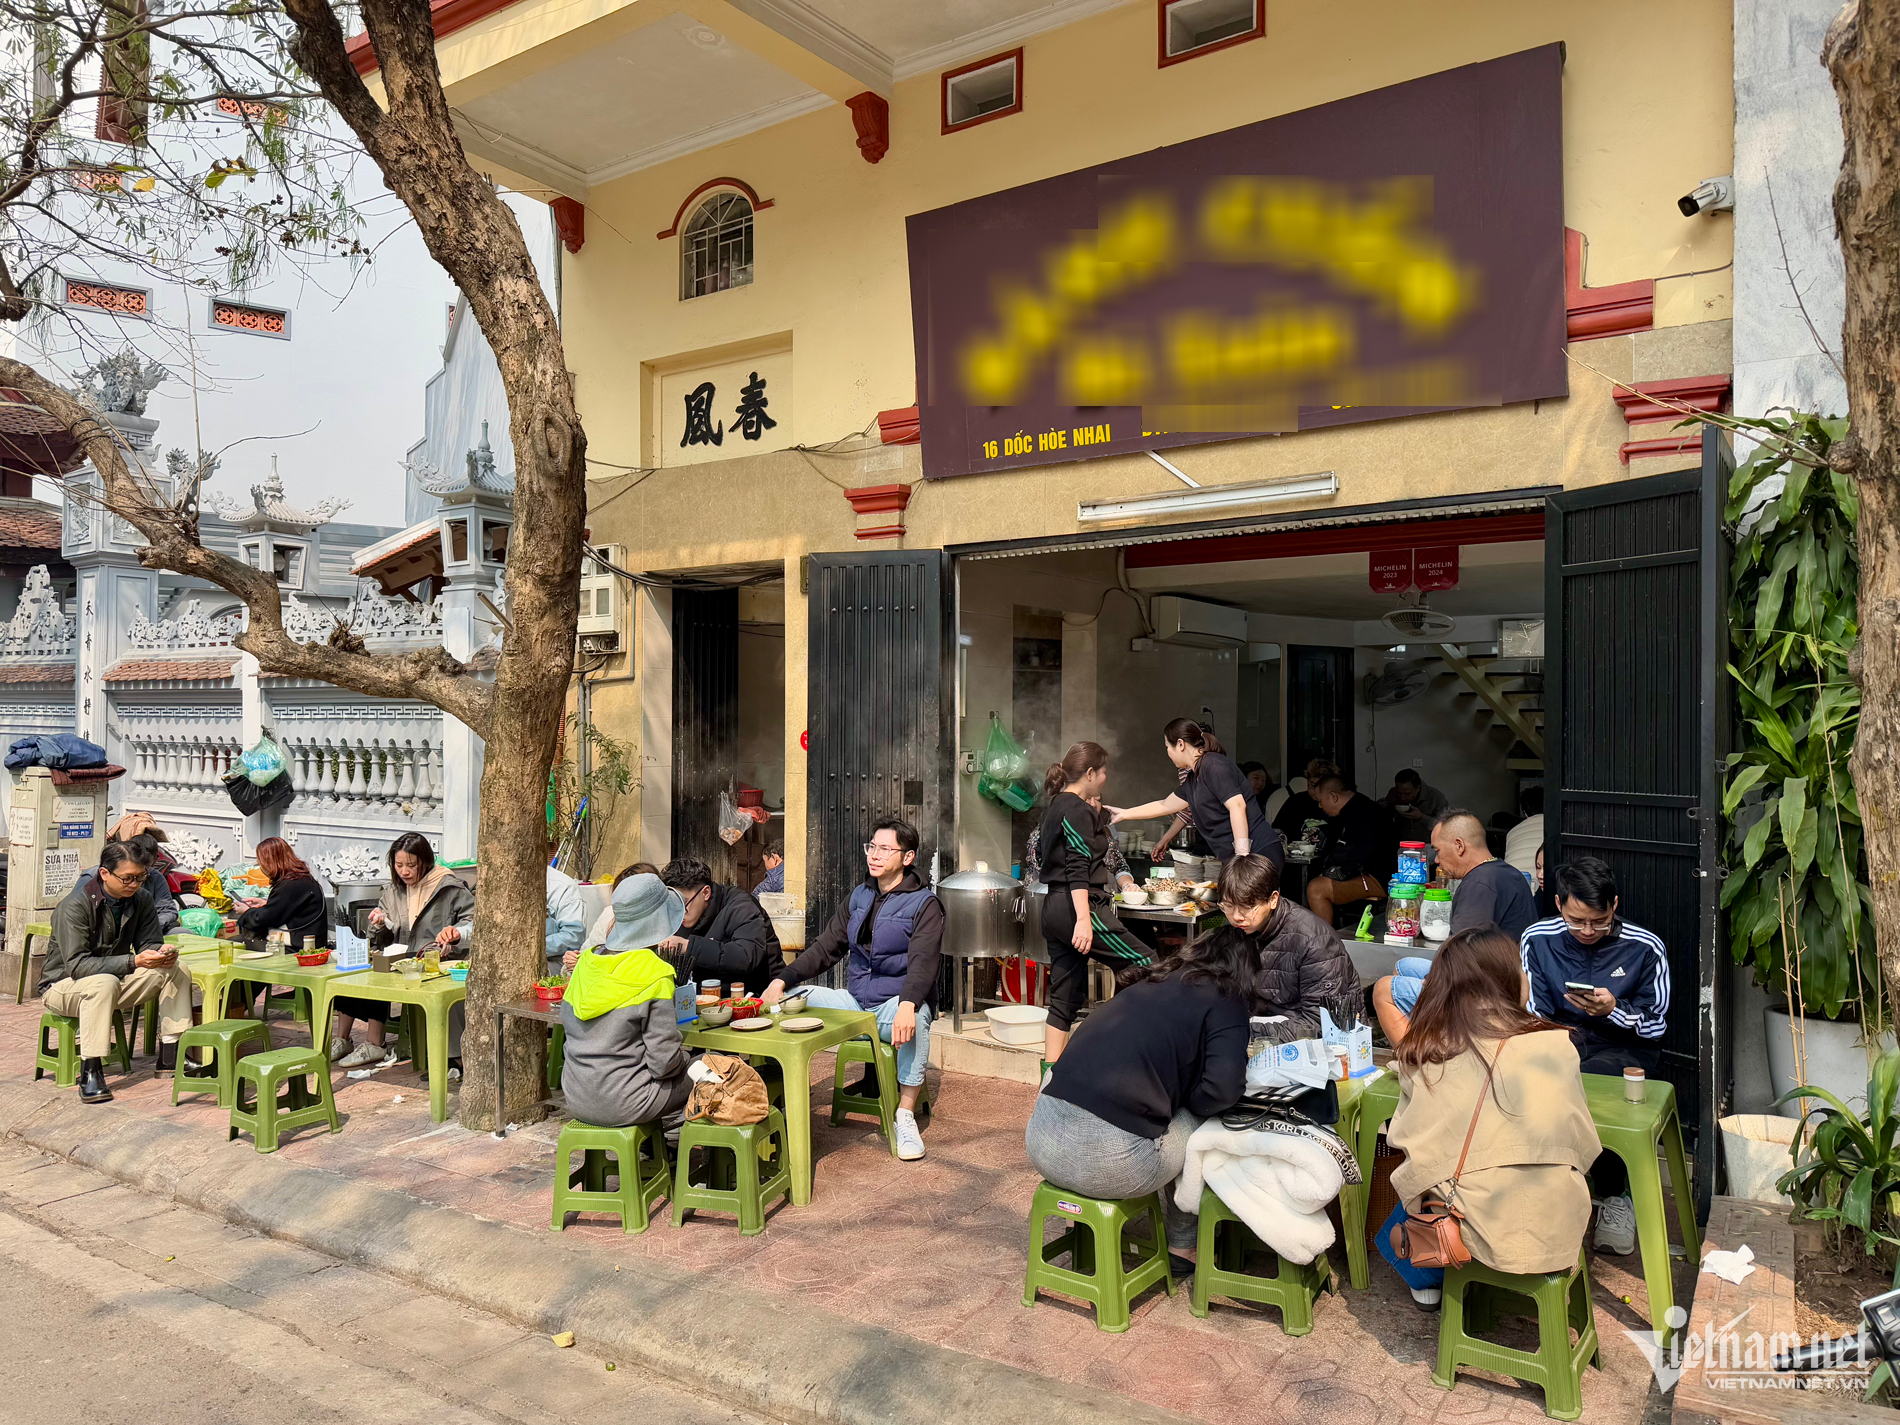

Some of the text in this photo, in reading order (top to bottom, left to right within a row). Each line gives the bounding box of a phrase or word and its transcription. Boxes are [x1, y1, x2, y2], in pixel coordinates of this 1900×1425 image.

[983, 423, 1111, 459] 16 DỐC HÒE NHAI
[1373, 564, 1407, 572] MICHELIN
[1419, 561, 1453, 570] MICHELIN
[45, 851, 61, 865] SỬA
[1273, 1122, 1299, 1135] KARL
